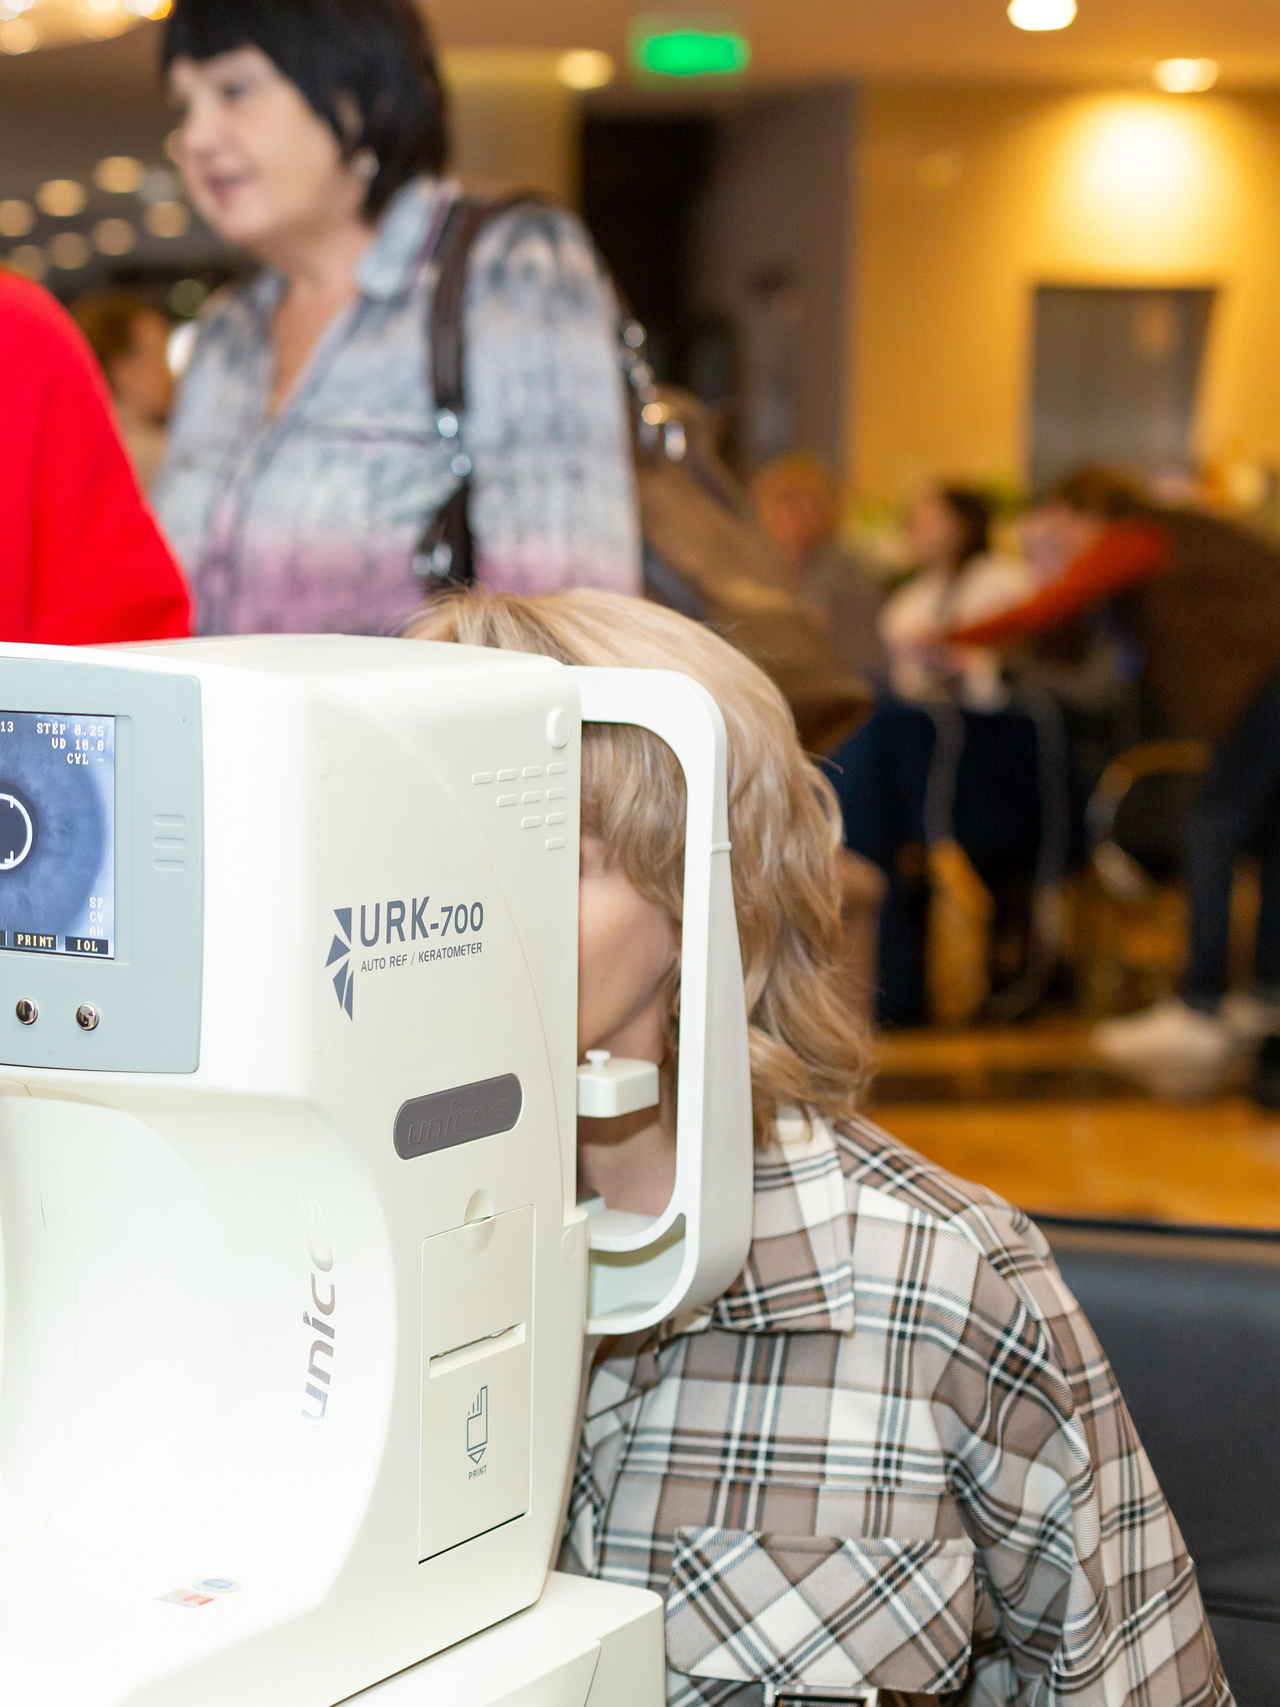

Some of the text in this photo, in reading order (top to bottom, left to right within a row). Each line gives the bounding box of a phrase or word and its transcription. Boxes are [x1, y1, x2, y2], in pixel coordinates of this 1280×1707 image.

[36, 722, 104, 737] STEP 0.25
[66, 752, 89, 765] CYL
[89, 896, 104, 909] SP
[89, 911, 104, 923] CY
[360, 896, 484, 948] URK-700
[17, 933, 54, 948] PRINT
[76, 938, 98, 952] IOL
[360, 957, 386, 973] AUTO
[389, 954, 408, 968] REF
[418, 942, 483, 963] KERATOMETER
[296, 1190, 336, 1428] unicos
[468, 1464, 487, 1480] PRINT
